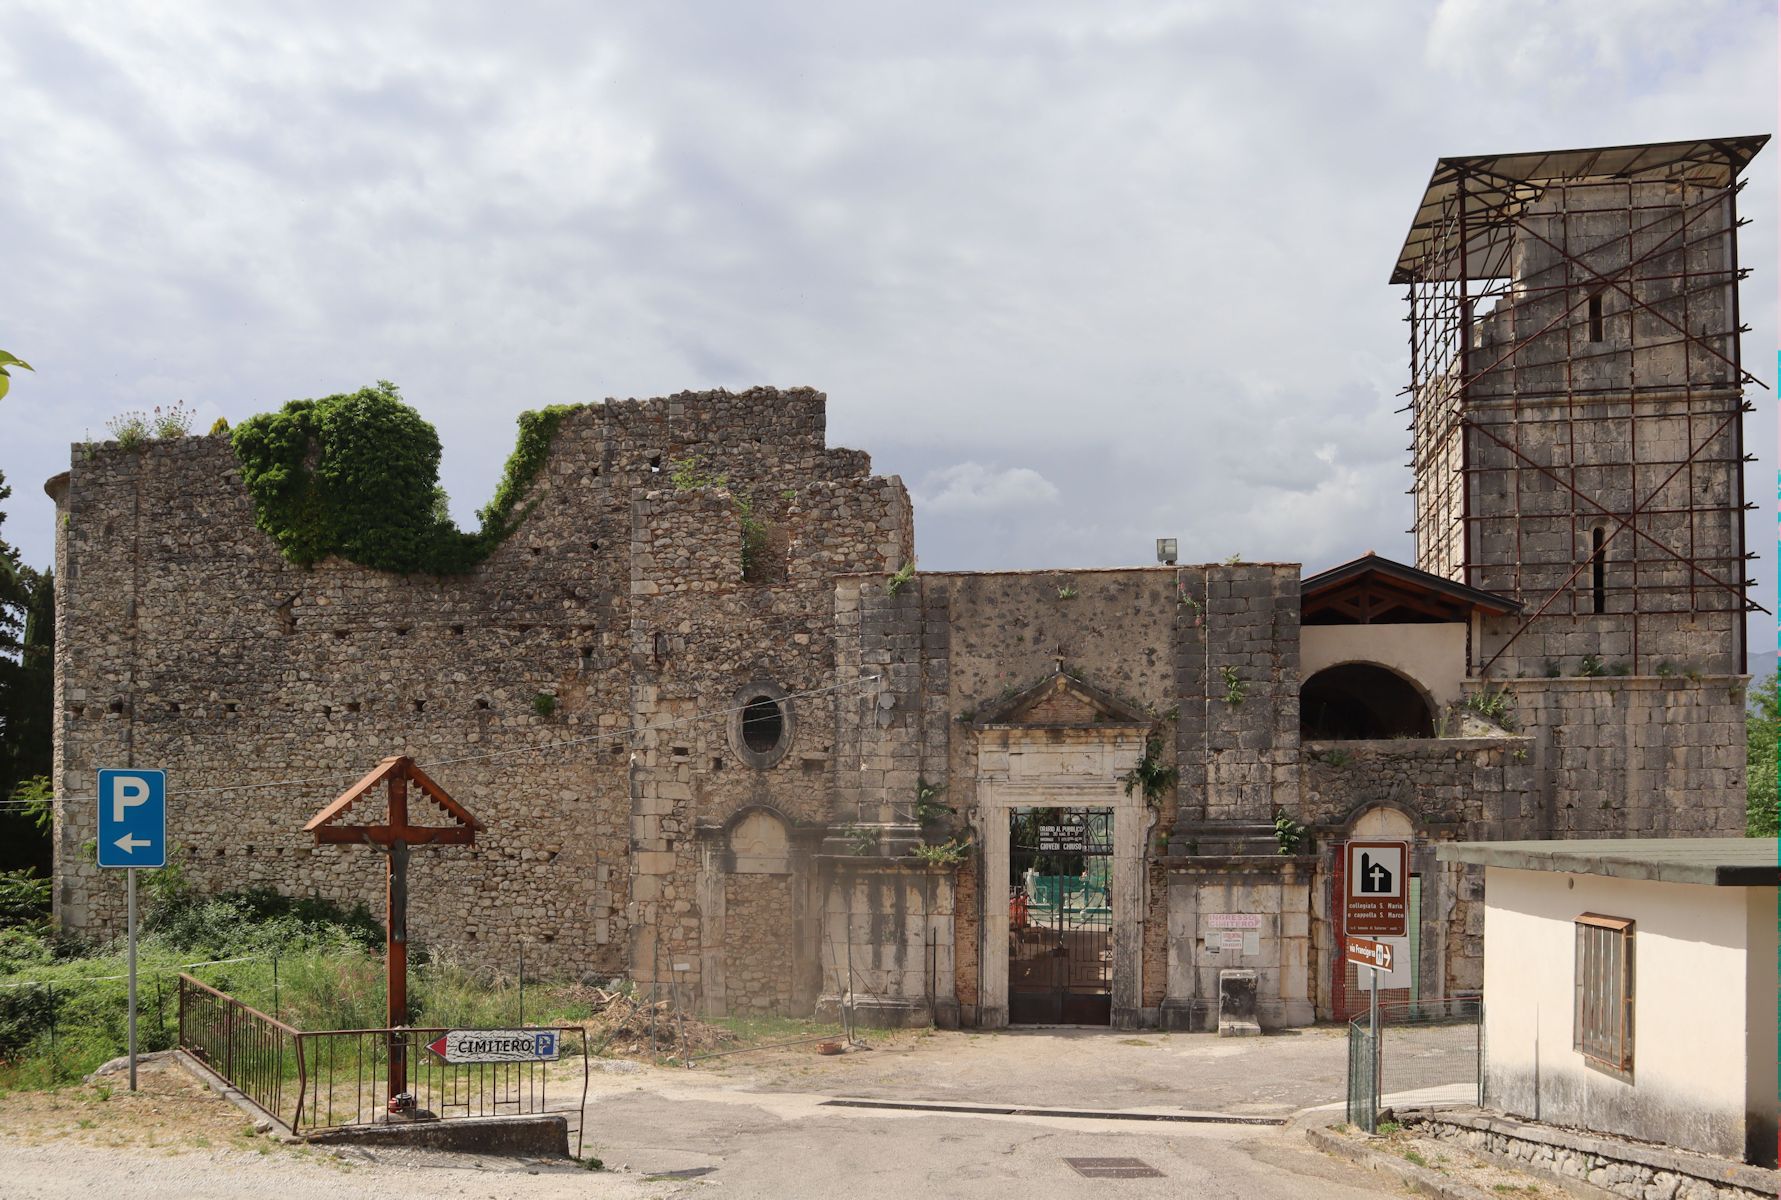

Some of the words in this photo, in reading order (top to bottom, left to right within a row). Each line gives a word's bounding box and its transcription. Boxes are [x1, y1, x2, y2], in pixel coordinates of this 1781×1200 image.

[113, 776, 150, 822] P
[1349, 902, 1377, 910] collegiata
[1210, 920, 1255, 928] CIMITERO
[1355, 943, 1376, 958] Francigena
[458, 1039, 531, 1054] CIMITERO
[538, 1035, 551, 1055] P
